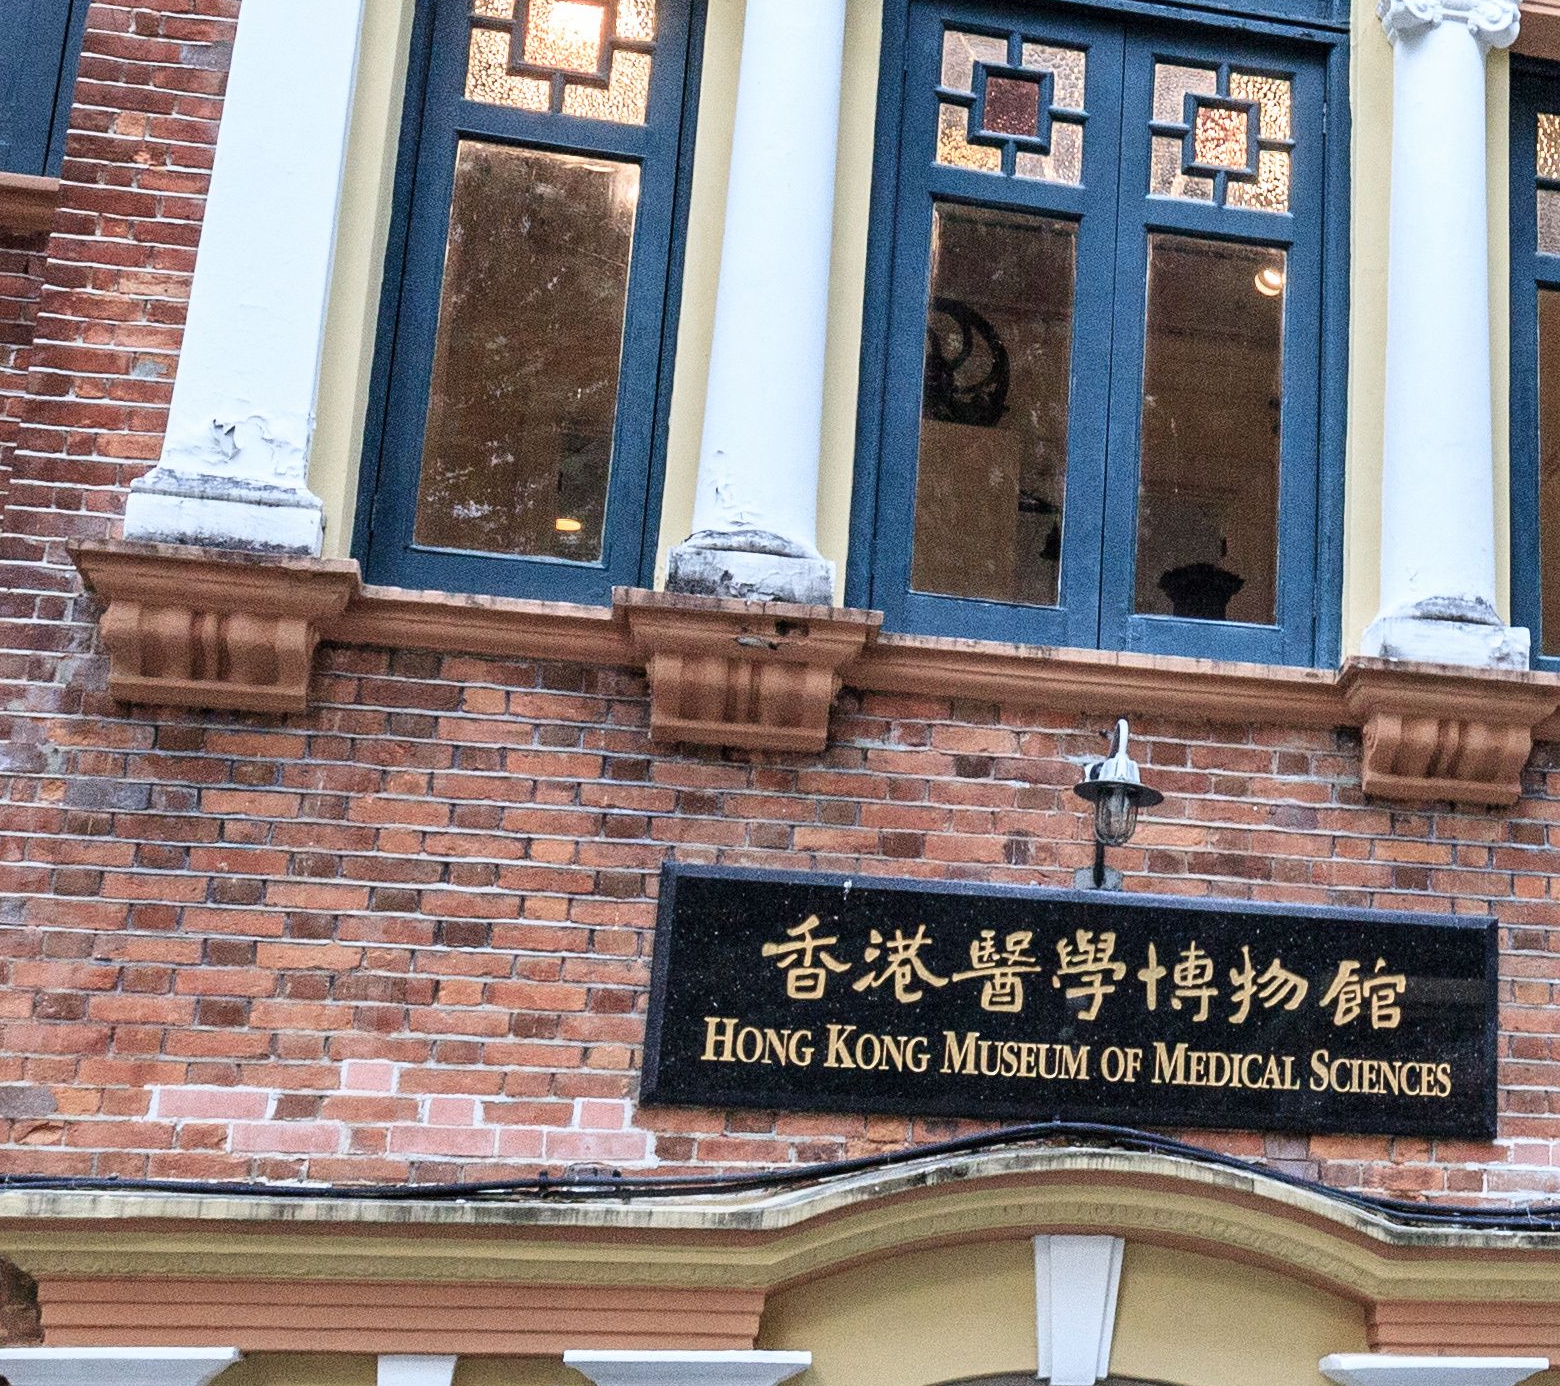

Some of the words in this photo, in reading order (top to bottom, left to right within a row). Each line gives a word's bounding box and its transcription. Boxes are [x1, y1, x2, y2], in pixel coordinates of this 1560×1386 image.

[762, 915, 1407, 1030] 香港醫學博物館
[701, 1016, 815, 1067] HONG
[825, 1024, 930, 1072] KONG
[941, 1031, 1089, 1080] MUSEUM
[1101, 1047, 1143, 1083] OF
[1153, 1042, 1300, 1090] MEDICAL
[1309, 1050, 1452, 1098] SCIENCES
